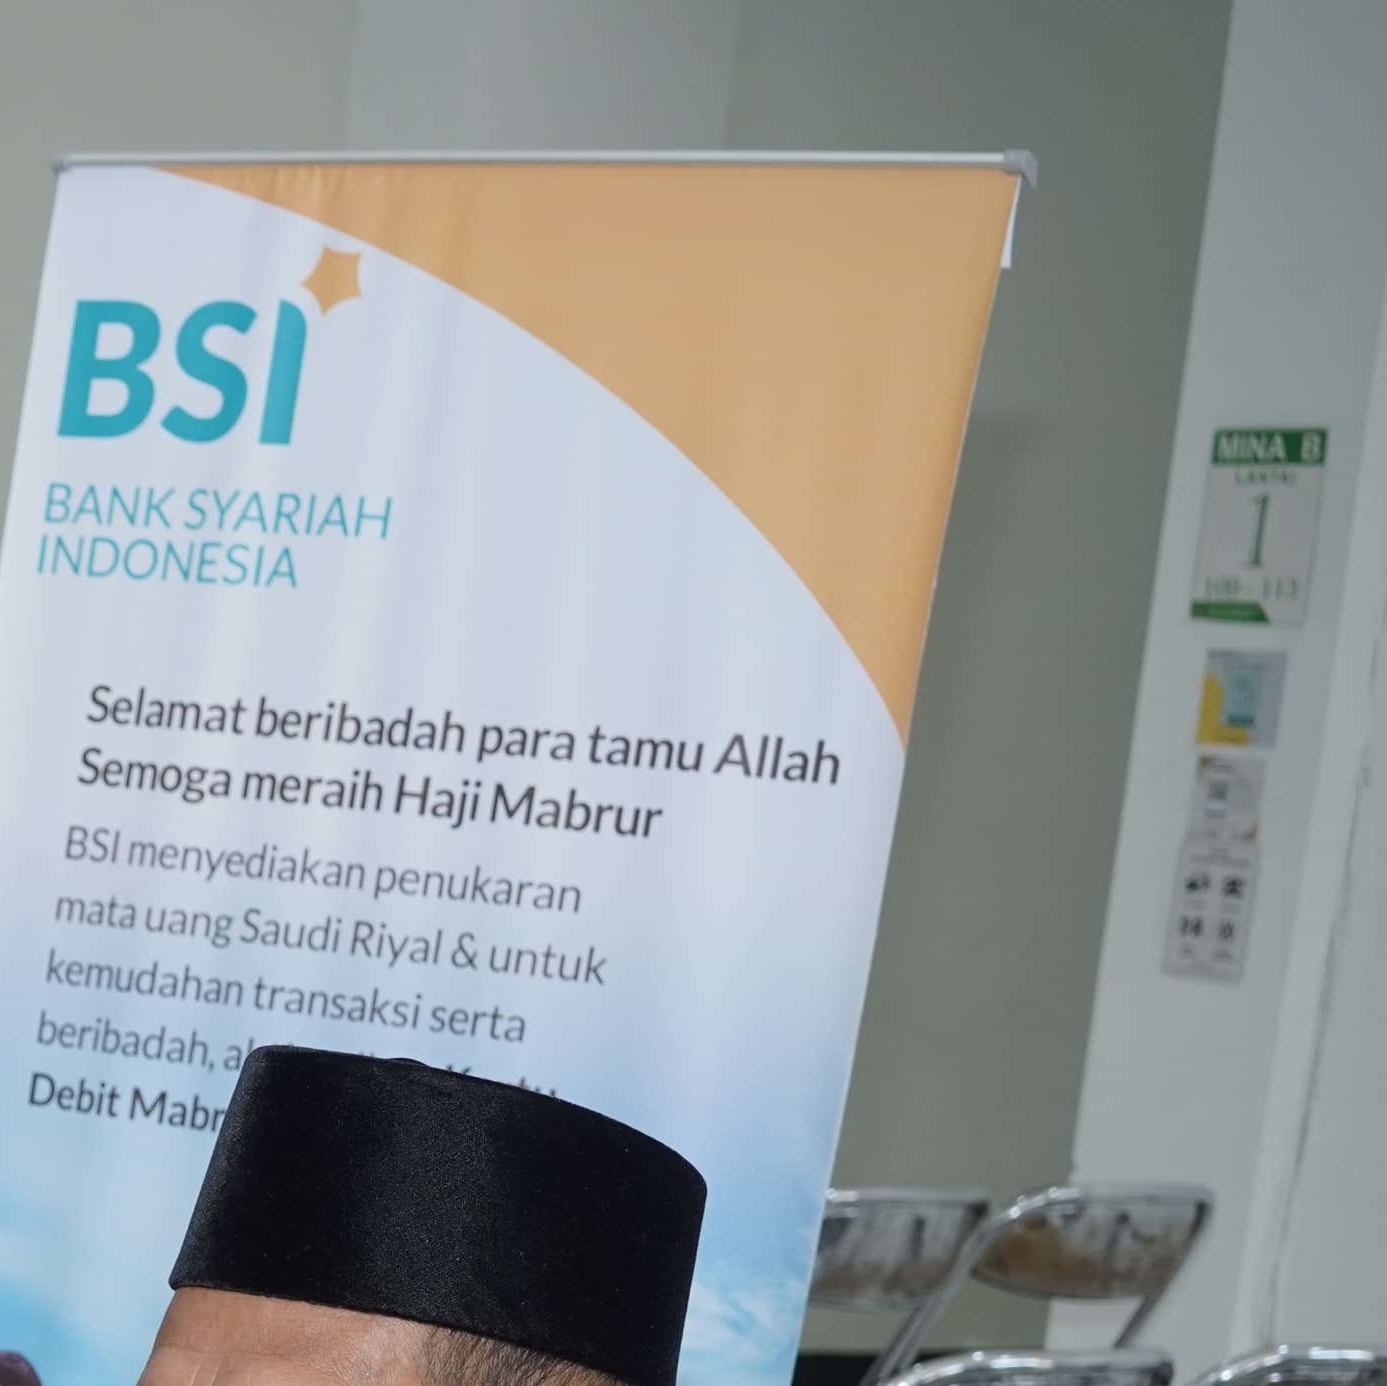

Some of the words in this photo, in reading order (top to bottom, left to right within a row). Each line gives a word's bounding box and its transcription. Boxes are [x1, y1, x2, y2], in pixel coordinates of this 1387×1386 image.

[56, 299, 308, 446] BSI
[45, 483, 174, 527] BANK
[185, 489, 391, 538] SYARIAH
[38, 535, 297, 588] INDONESIA
[86, 684, 247, 735] Selamat
[254, 696, 466, 754] beribadah
[476, 725, 576, 764] para
[588, 725, 705, 773] tamu
[712, 733, 840, 785] Allah
[77, 746, 232, 804] Semoga
[241, 769, 384, 813] meraih
[393, 773, 482, 830] Haji
[489, 780, 664, 839] Mabrur
[65, 825, 121, 864] BSI
[128, 841, 365, 890] menyediakan
[373, 865, 581, 913] penukaran
[55, 896, 137, 930] mata
[145, 907, 233, 949] uang
[240, 908, 342, 953] Saudi
[350, 920, 443, 967] Riyal
[451, 932, 478, 970] &
[489, 945, 607, 985] untuk
[46, 948, 244, 1007] kemudahan
[254, 978, 422, 1029] transaksi
[429, 1006, 525, 1042] serta
[37, 1010, 214, 1071] beribadah,
[28, 1071, 120, 1118] Debit
